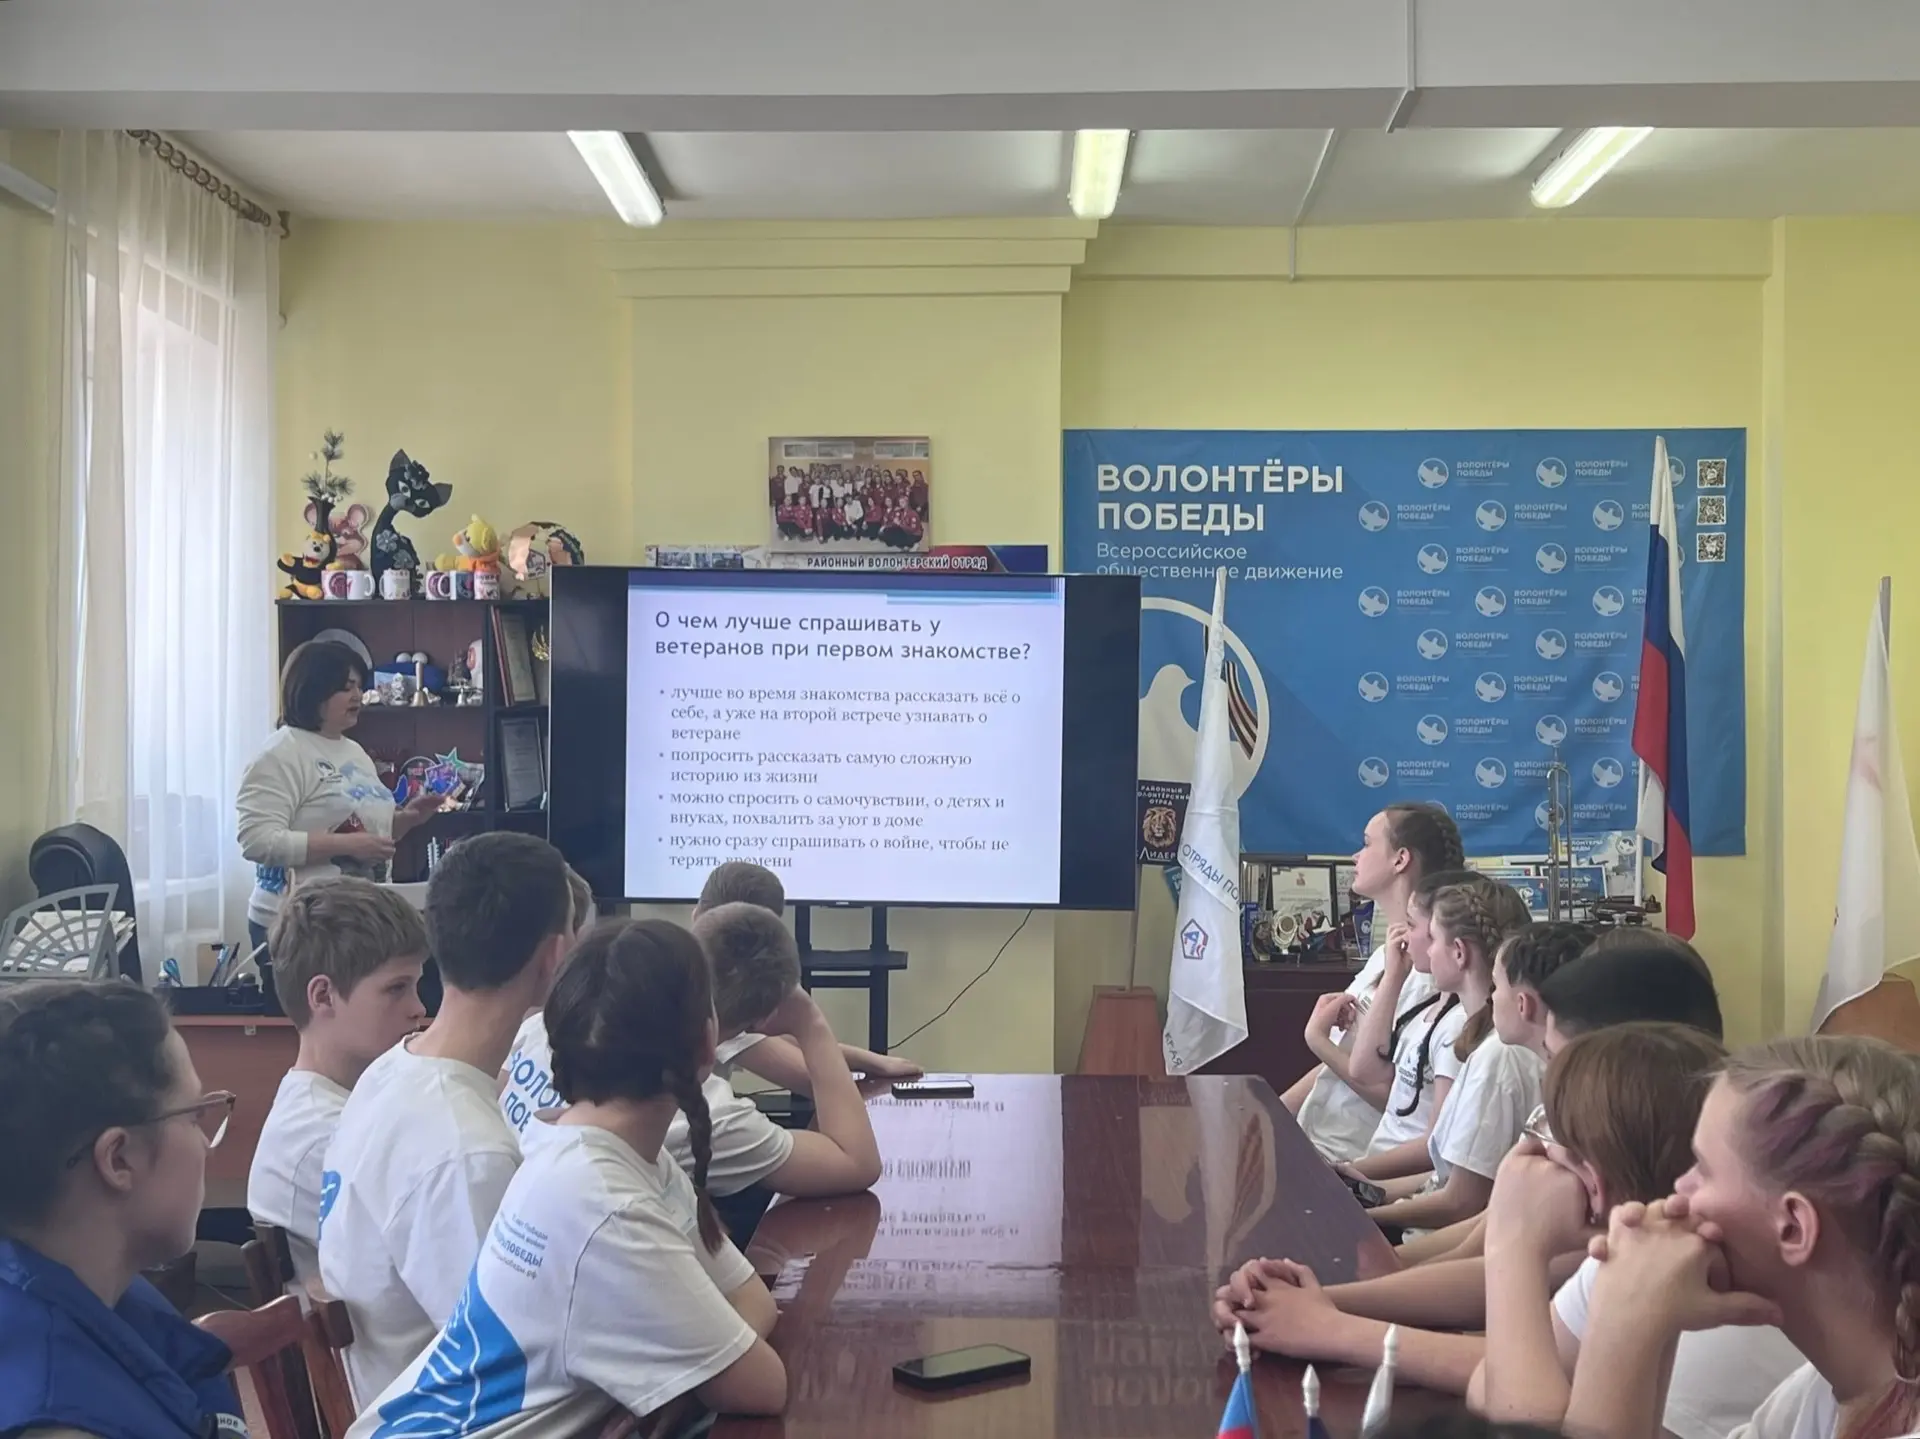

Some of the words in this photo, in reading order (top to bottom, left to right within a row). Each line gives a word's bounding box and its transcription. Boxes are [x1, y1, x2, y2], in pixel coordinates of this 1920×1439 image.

[1097, 459, 1343, 493] ВОЛОНТЁРЫ
[1574, 468, 1612, 476] ПОБЕДЫ
[1098, 502, 1264, 536] ПОБЕДЫ
[1397, 512, 1434, 520] ПОБЕДЫ
[1514, 511, 1551, 519] ПОБЕДЫ
[1097, 542, 1248, 560] Всероссийское
[1456, 555, 1493, 563] ПОБЕДЫ
[1574, 554, 1612, 562] ПОБЕДЫ
[807, 555, 865, 569] РАЙОННЫЙ
[868, 555, 949, 570] ВОЛОНТЕРСКИЙ
[951, 557, 989, 571] ОТРЯД
[1097, 563, 1239, 579] общественне
[1244, 565, 1344, 580] движение
[1397, 598, 1434, 606] ПОБЕДЫ
[1513, 598, 1551, 606] ПОБЕДЫ
[655, 611, 670, 629] О
[678, 614, 719, 630] чем
[725, 616, 792, 635] лучше
[799, 616, 922, 635] спрашивать
[929, 619, 941, 636] у
[655, 640, 764, 658] ветеранов
[772, 643, 809, 659] при
[817, 644, 893, 661] первом
[901, 643, 1031, 661] знакомстве?
[671, 686, 723, 702] лучше
[727, 688, 744, 699] во
[749, 688, 796, 702] время
[800, 689, 890, 703] знакомства
[895, 690, 979, 705] рассказать
[984, 689, 1008, 704] всё
[1011, 694, 1021, 704] о
[671, 704, 708, 721] себе,
[712, 710, 721, 719] а
[725, 709, 756, 723] уже
[760, 709, 778, 720] на
[783, 706, 837, 724] второй
[842, 710, 902, 725] встрече
[905, 711, 975, 725] узнавать
[978, 712, 988, 723] о
[671, 728, 741, 742] ветеране
[671, 750, 754, 765] попросить
[758, 750, 842, 766] рассказать
[846, 752, 896, 768] самую
[900, 752, 972, 768] сложную
[671, 770, 739, 785] историю
[743, 771, 761, 783] из
[766, 772, 818, 783] жизни
[670, 792, 724, 805] можно
[728, 793, 799, 808] спросить
[803, 795, 813, 806] о
[817, 795, 930, 809] самочувствии,
[934, 797, 944, 807] о
[947, 796, 991, 809] детях
[994, 797, 1005, 808] и
[1136, 791, 1191, 800] ОЛОНТЁРСКИЙ
[670, 812, 729, 827] внуках,
[732, 813, 814, 826] похвалить
[818, 815, 834, 826] за
[838, 815, 868, 829] уют
[872, 816, 881, 826] в
[885, 815, 924, 828] доме
[670, 834, 721, 850] нужно
[725, 835, 768, 851] сразу
[771, 836, 866, 851] спрашивать
[869, 838, 879, 849] о
[883, 834, 934, 852] войне,
[938, 835, 986, 851] чтобы
[991, 839, 1010, 851] не
[669, 855, 721, 869] терять
[1182, 843, 1224, 884] ОТРЯДЫ
